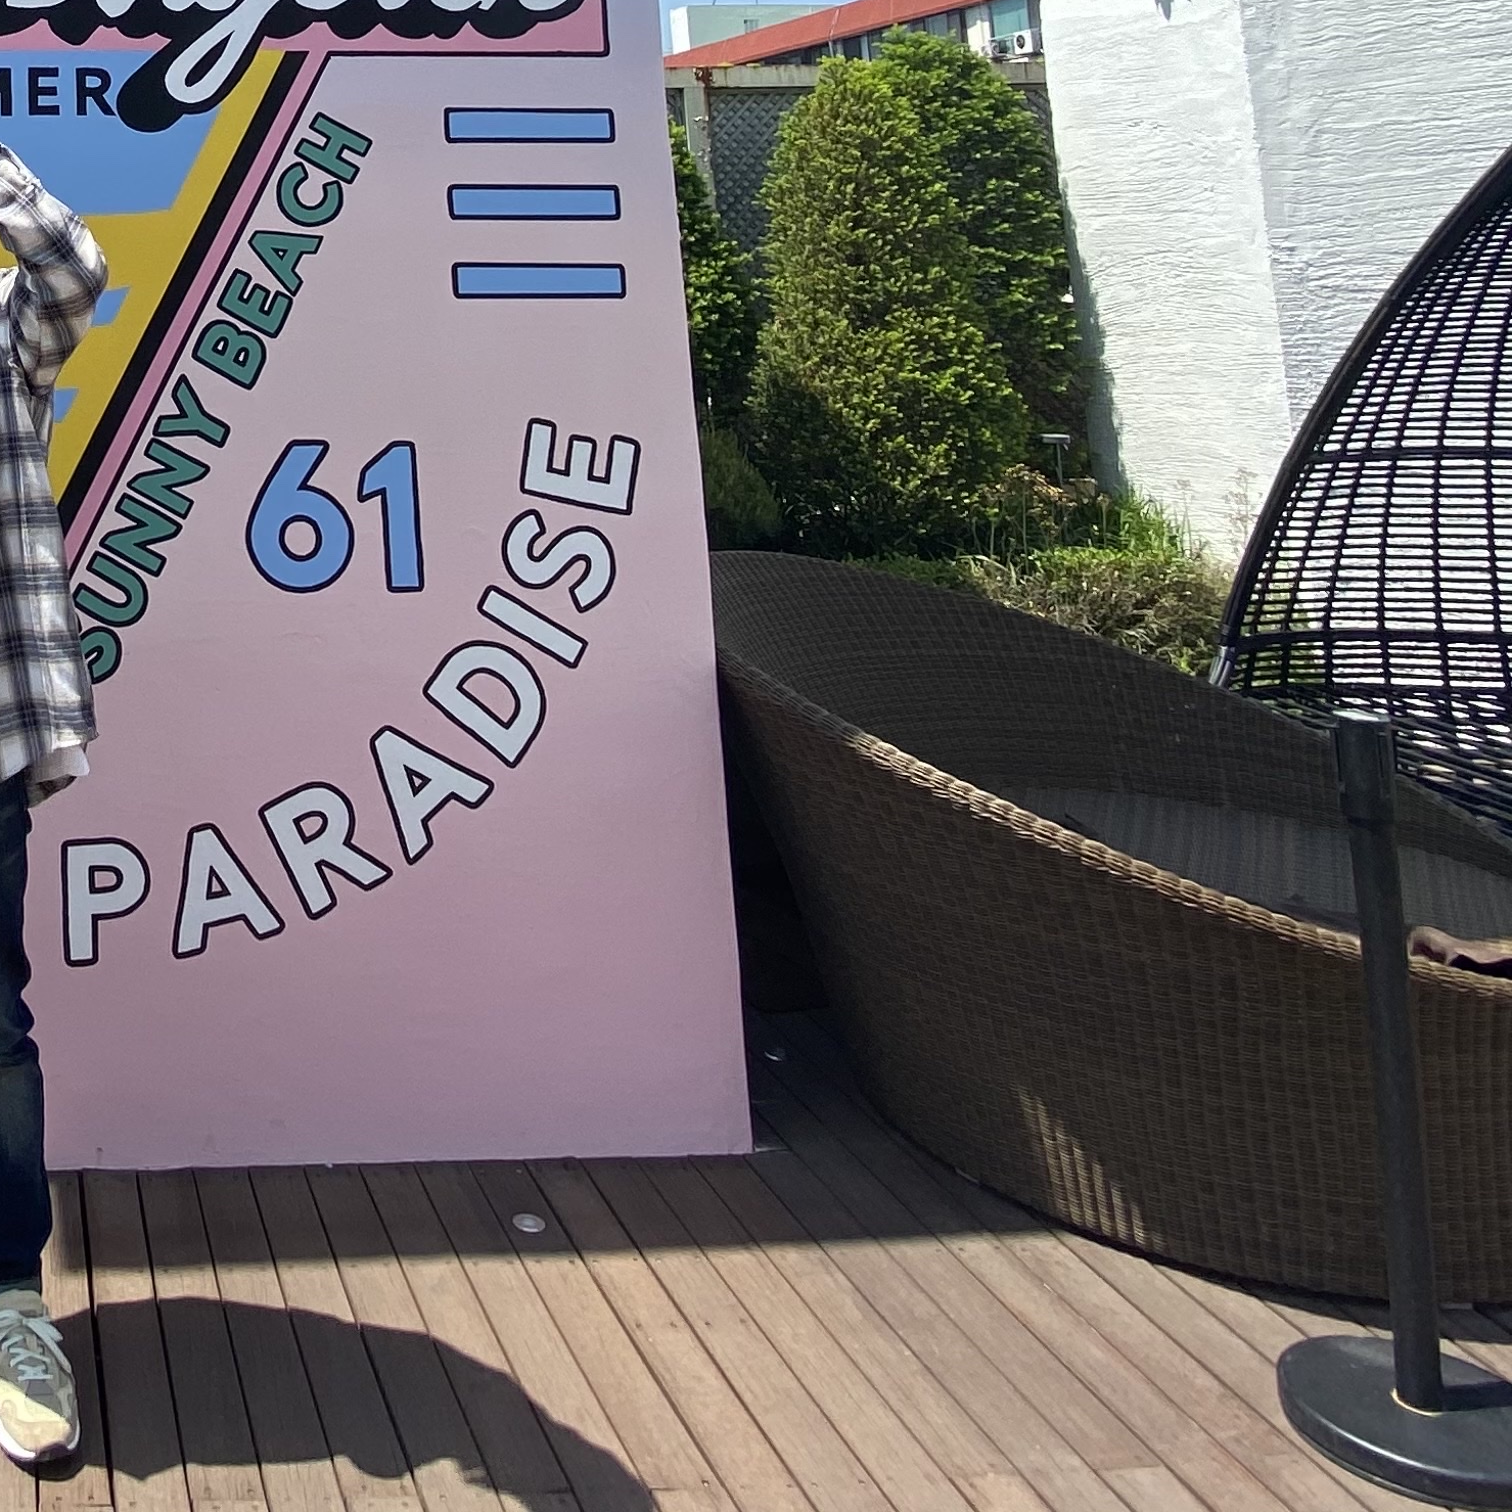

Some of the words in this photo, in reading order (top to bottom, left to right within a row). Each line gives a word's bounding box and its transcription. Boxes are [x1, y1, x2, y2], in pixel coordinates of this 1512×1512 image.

[192, 112, 372, 390] BEACH
[245, 439, 424, 593] 61
[61, 417, 641, 967] PARADISE
